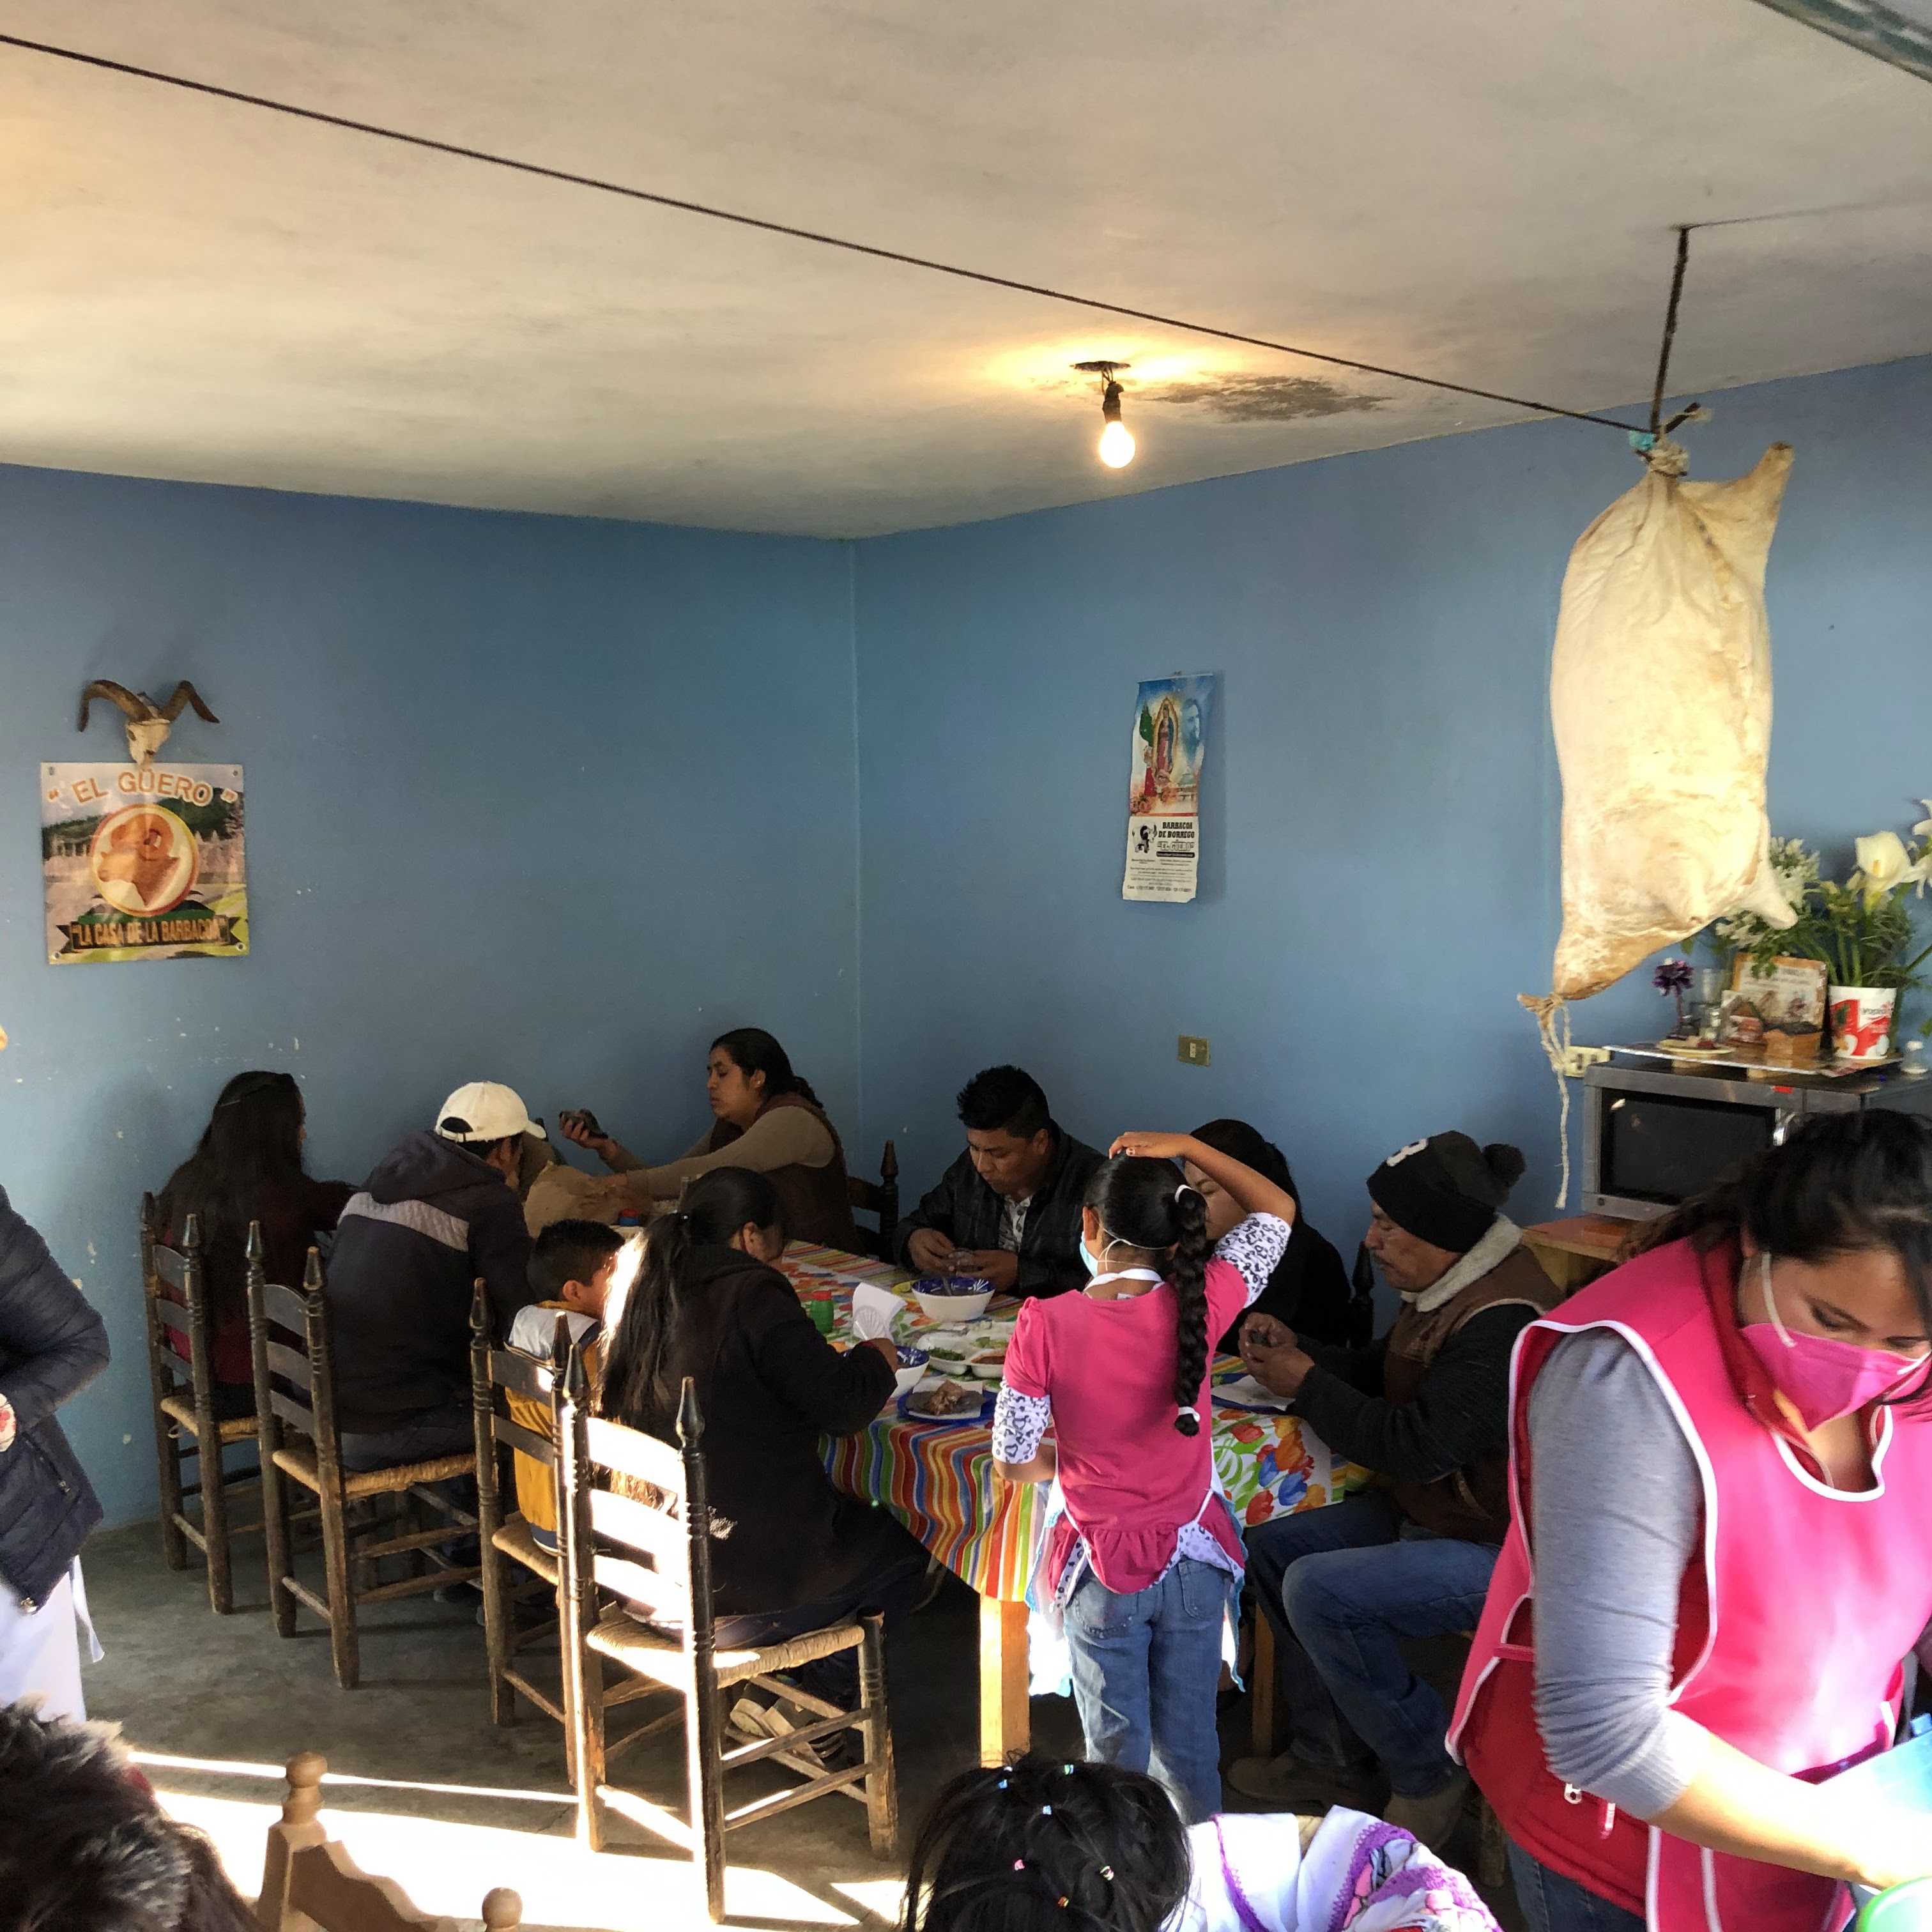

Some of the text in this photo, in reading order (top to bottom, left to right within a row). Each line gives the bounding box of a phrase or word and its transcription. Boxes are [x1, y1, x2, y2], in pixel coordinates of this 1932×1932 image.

[71, 778, 109, 803] EL
[118, 767, 213, 807] GÜERO
[95, 922, 124, 946] CASA
[126, 921, 144, 944] DE
[146, 919, 160, 942] LA
